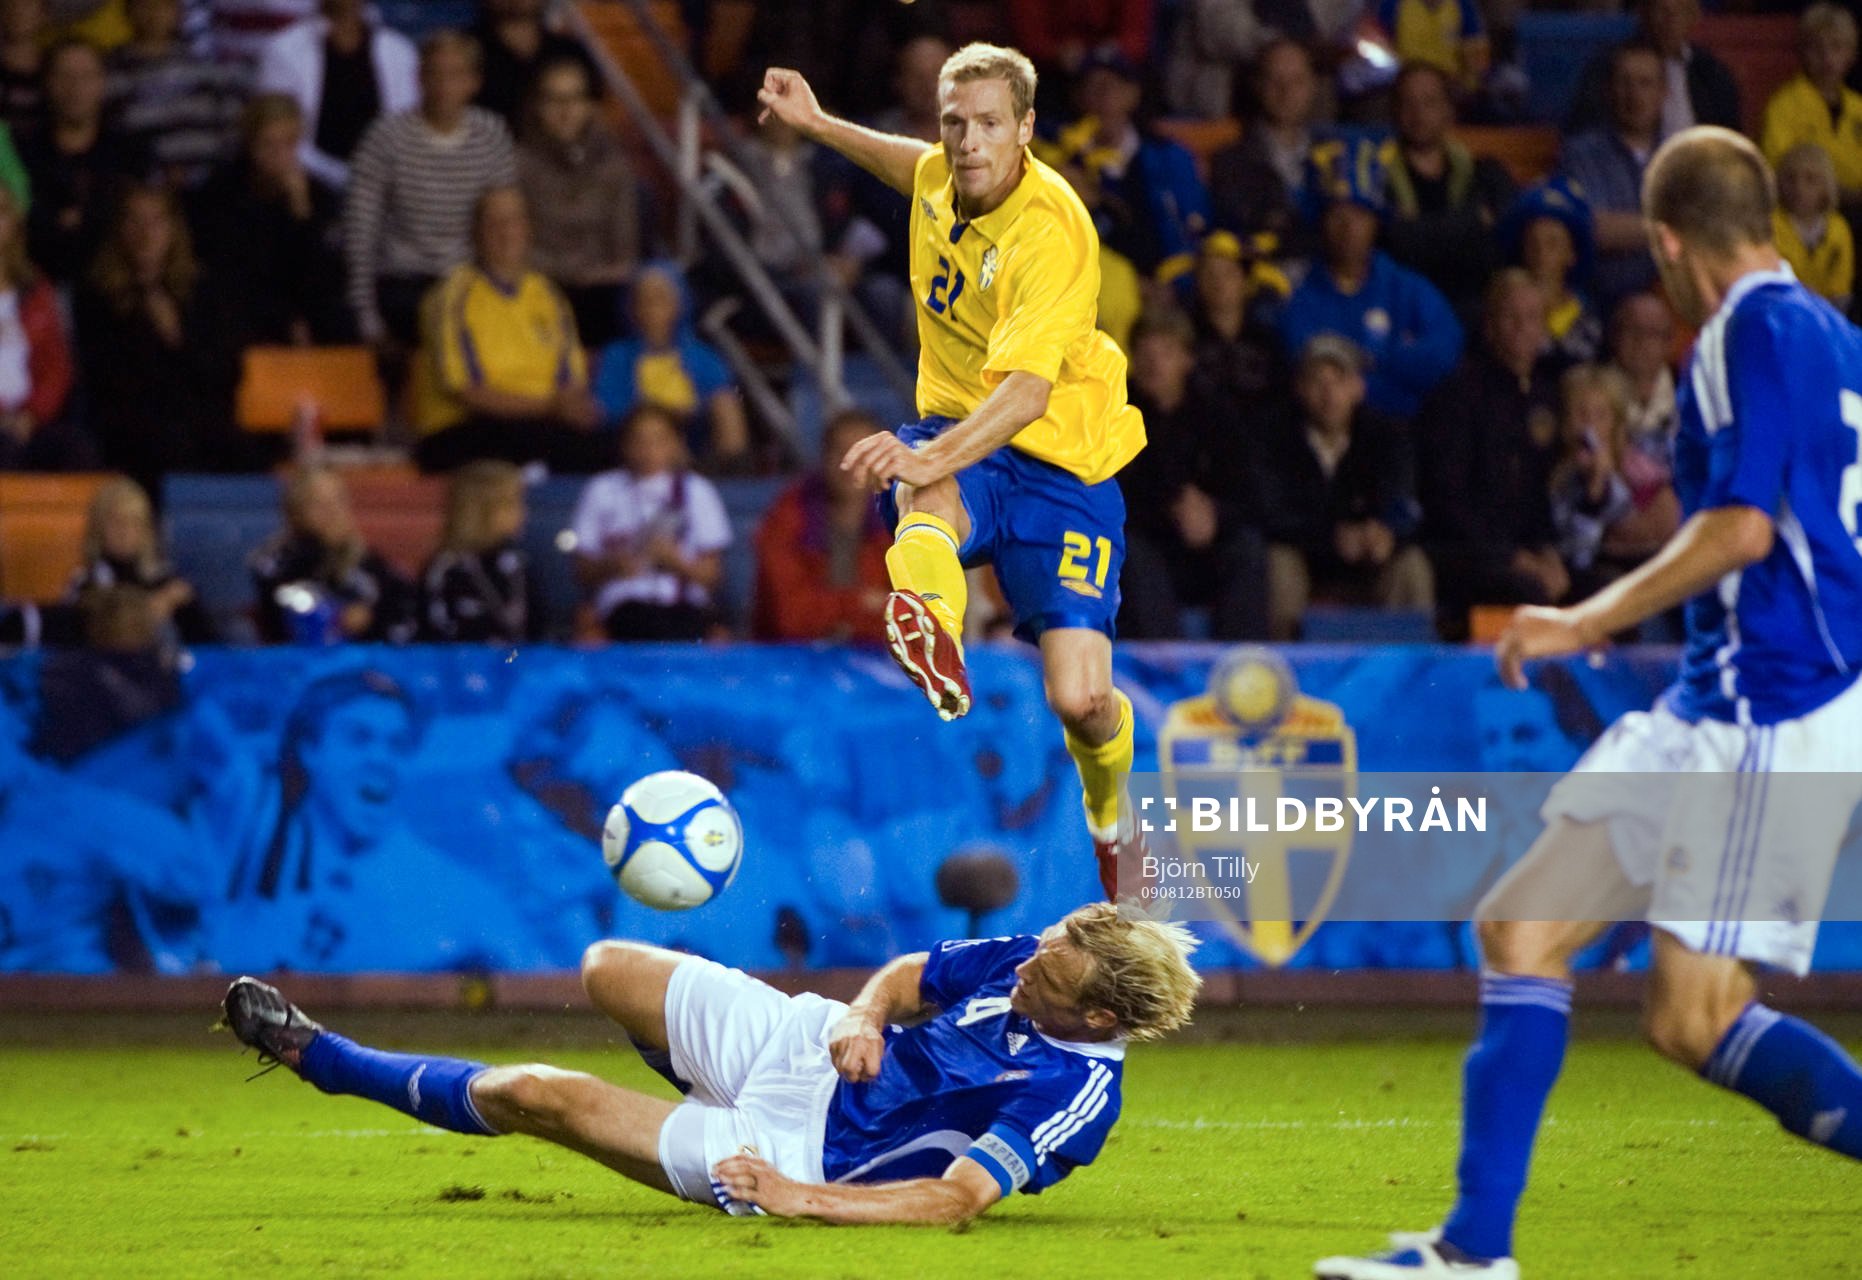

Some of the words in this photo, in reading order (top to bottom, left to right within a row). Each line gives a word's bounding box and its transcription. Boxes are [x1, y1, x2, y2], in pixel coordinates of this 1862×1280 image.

[926, 254, 966, 314] 21
[1057, 530, 1112, 590] 21
[976, 1135, 1026, 1185] CAPTAIN
